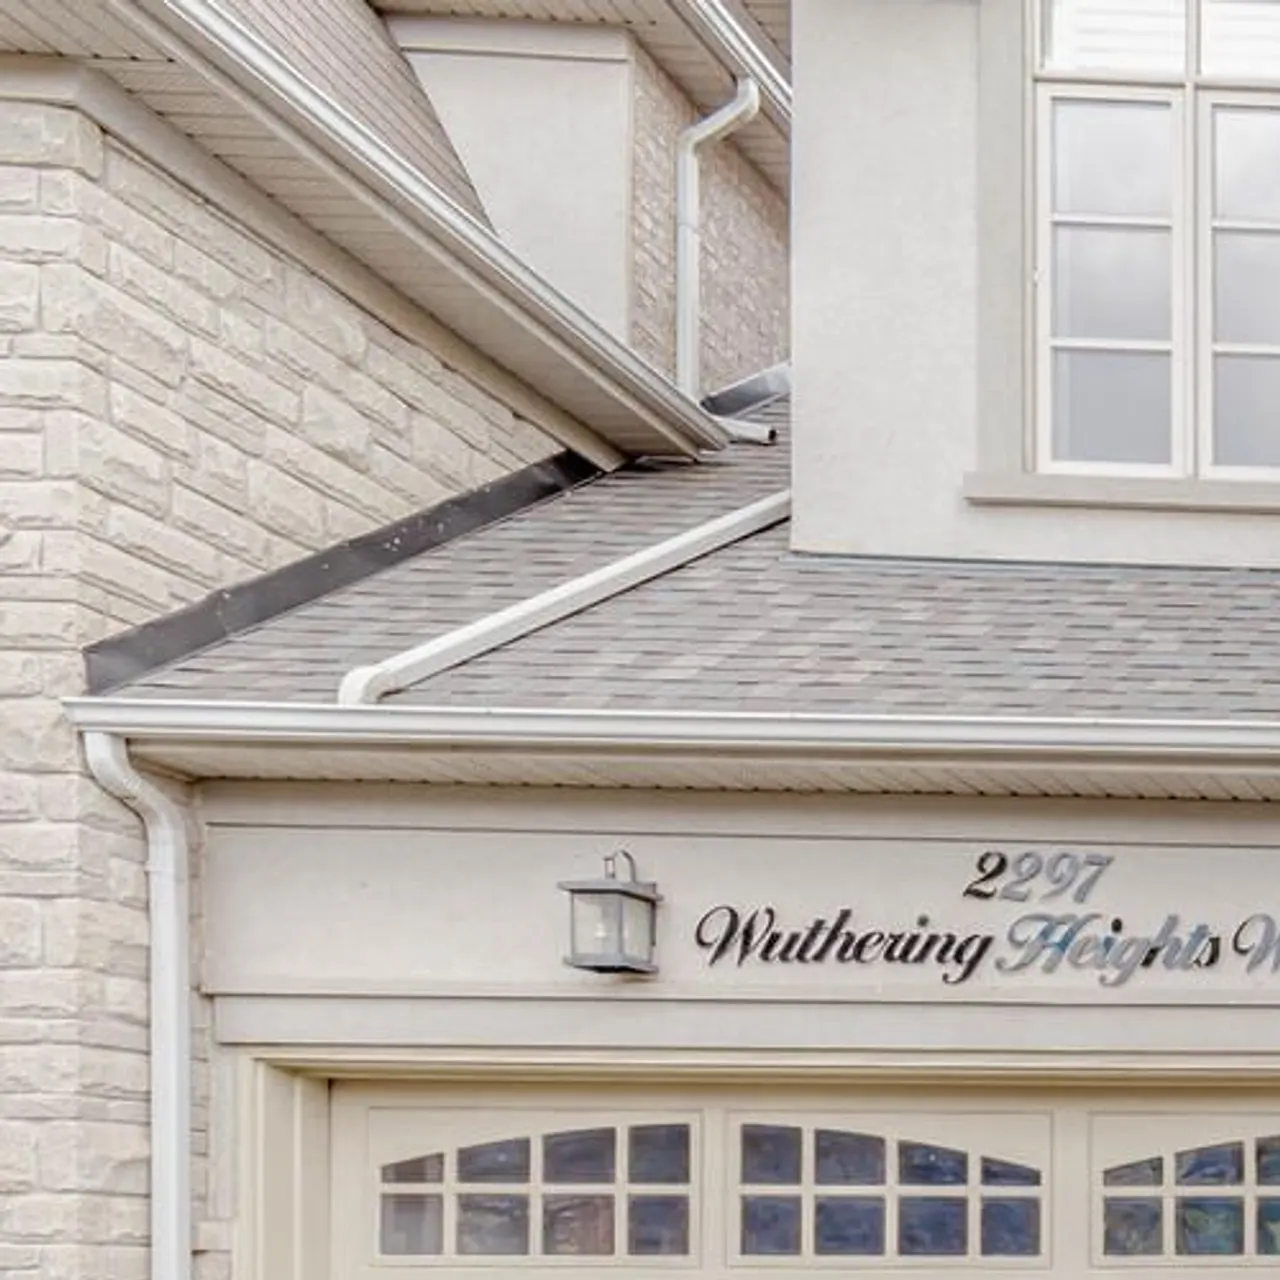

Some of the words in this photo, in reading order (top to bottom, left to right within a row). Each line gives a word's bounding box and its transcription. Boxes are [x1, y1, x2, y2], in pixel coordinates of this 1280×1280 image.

[963, 851, 1114, 903] 2297
[694, 905, 995, 985] Wuthering
[995, 912, 1221, 987] Heights
